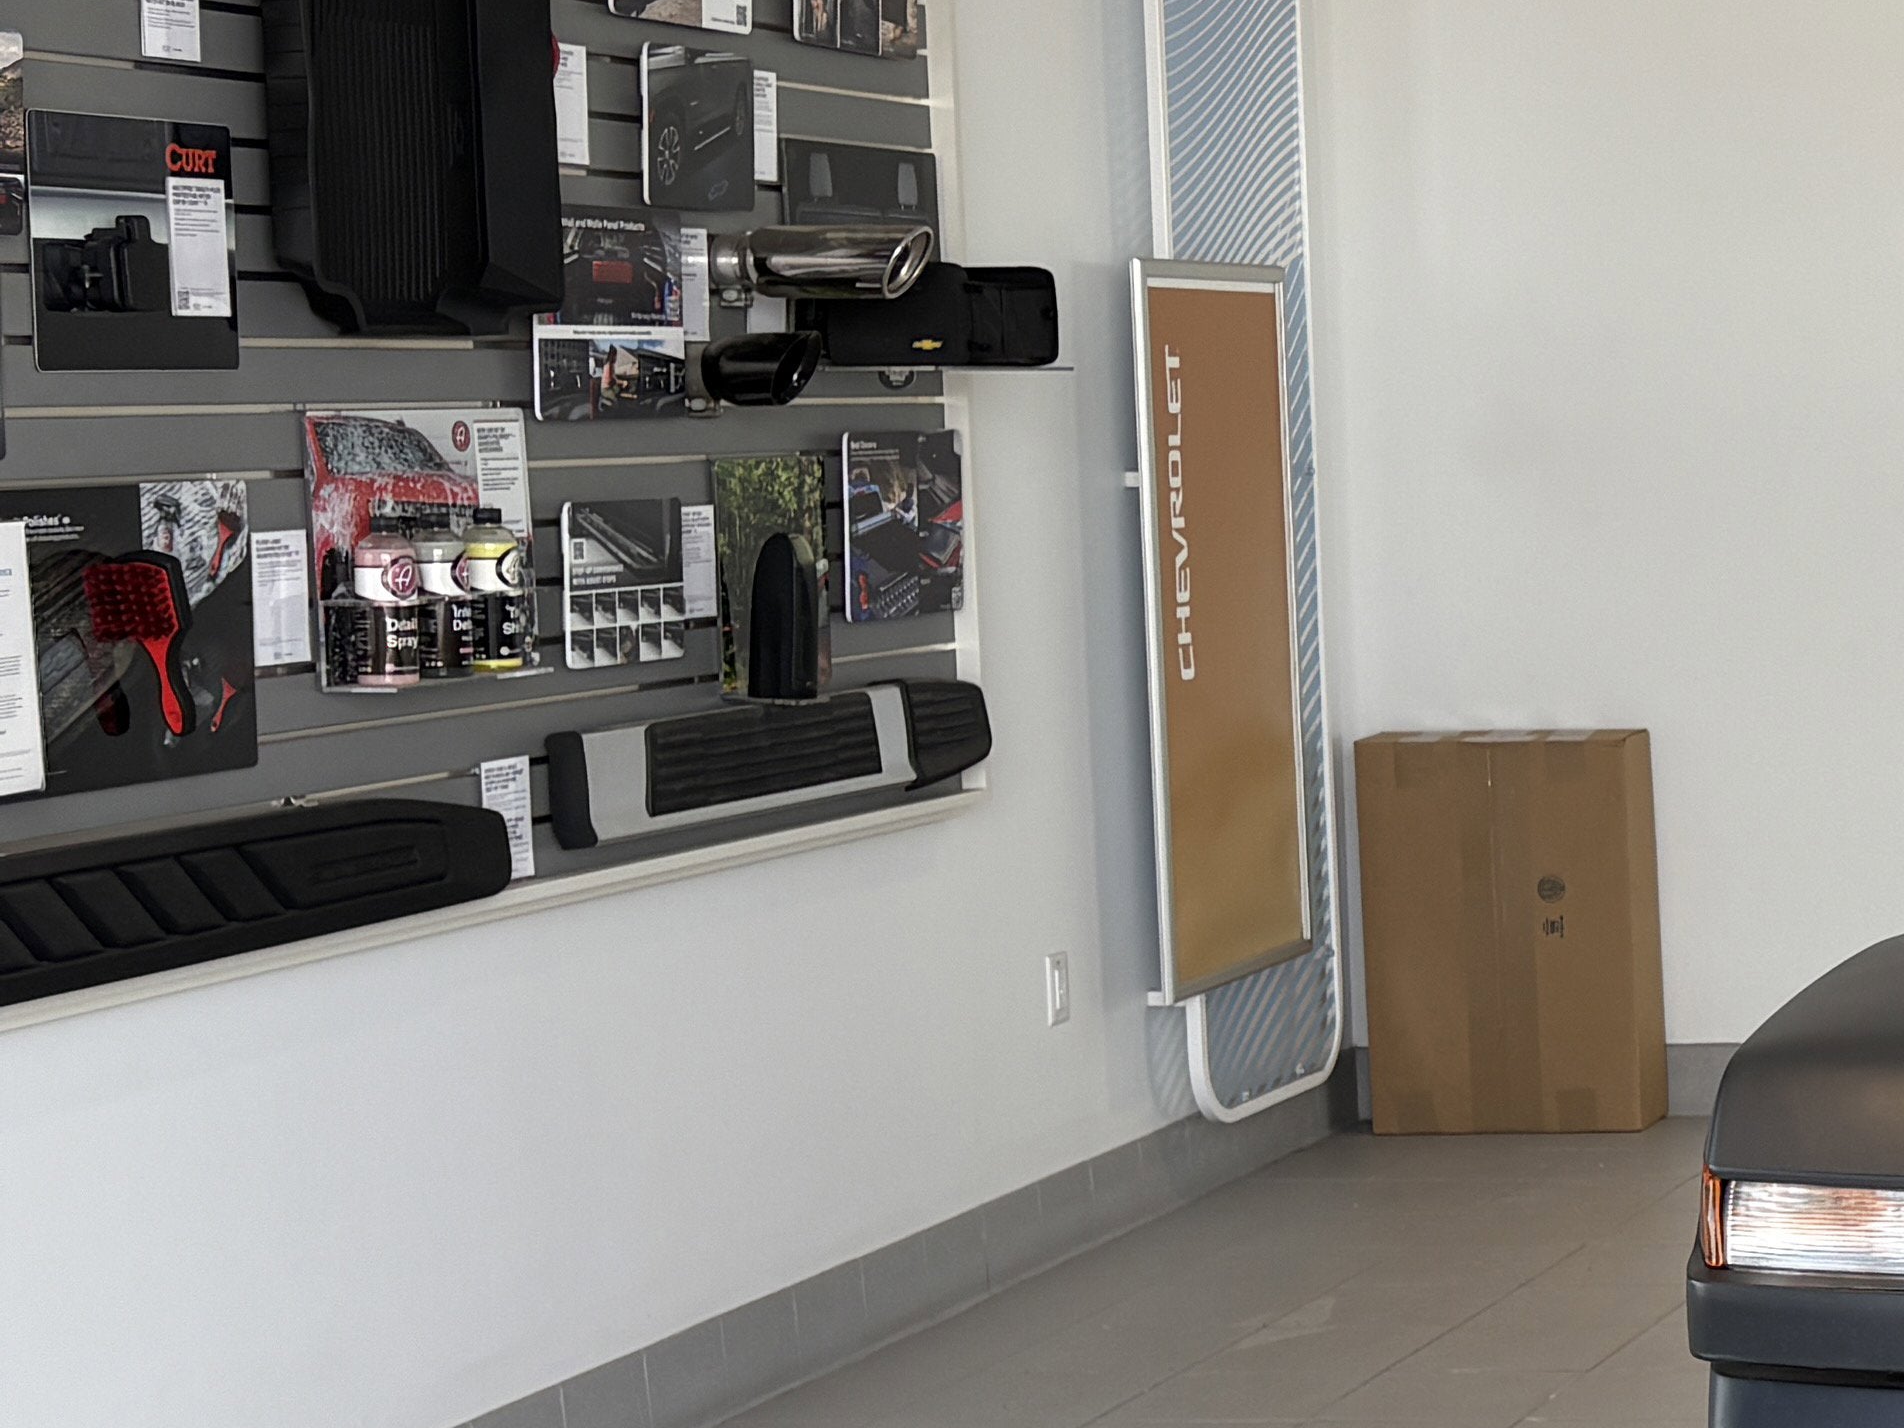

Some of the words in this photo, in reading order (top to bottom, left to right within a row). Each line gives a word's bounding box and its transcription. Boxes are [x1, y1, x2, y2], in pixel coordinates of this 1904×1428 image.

[165, 143, 217, 173] CURT
[1165, 345, 1196, 681] CHEVROLET
[386, 634, 418, 650] Spray
